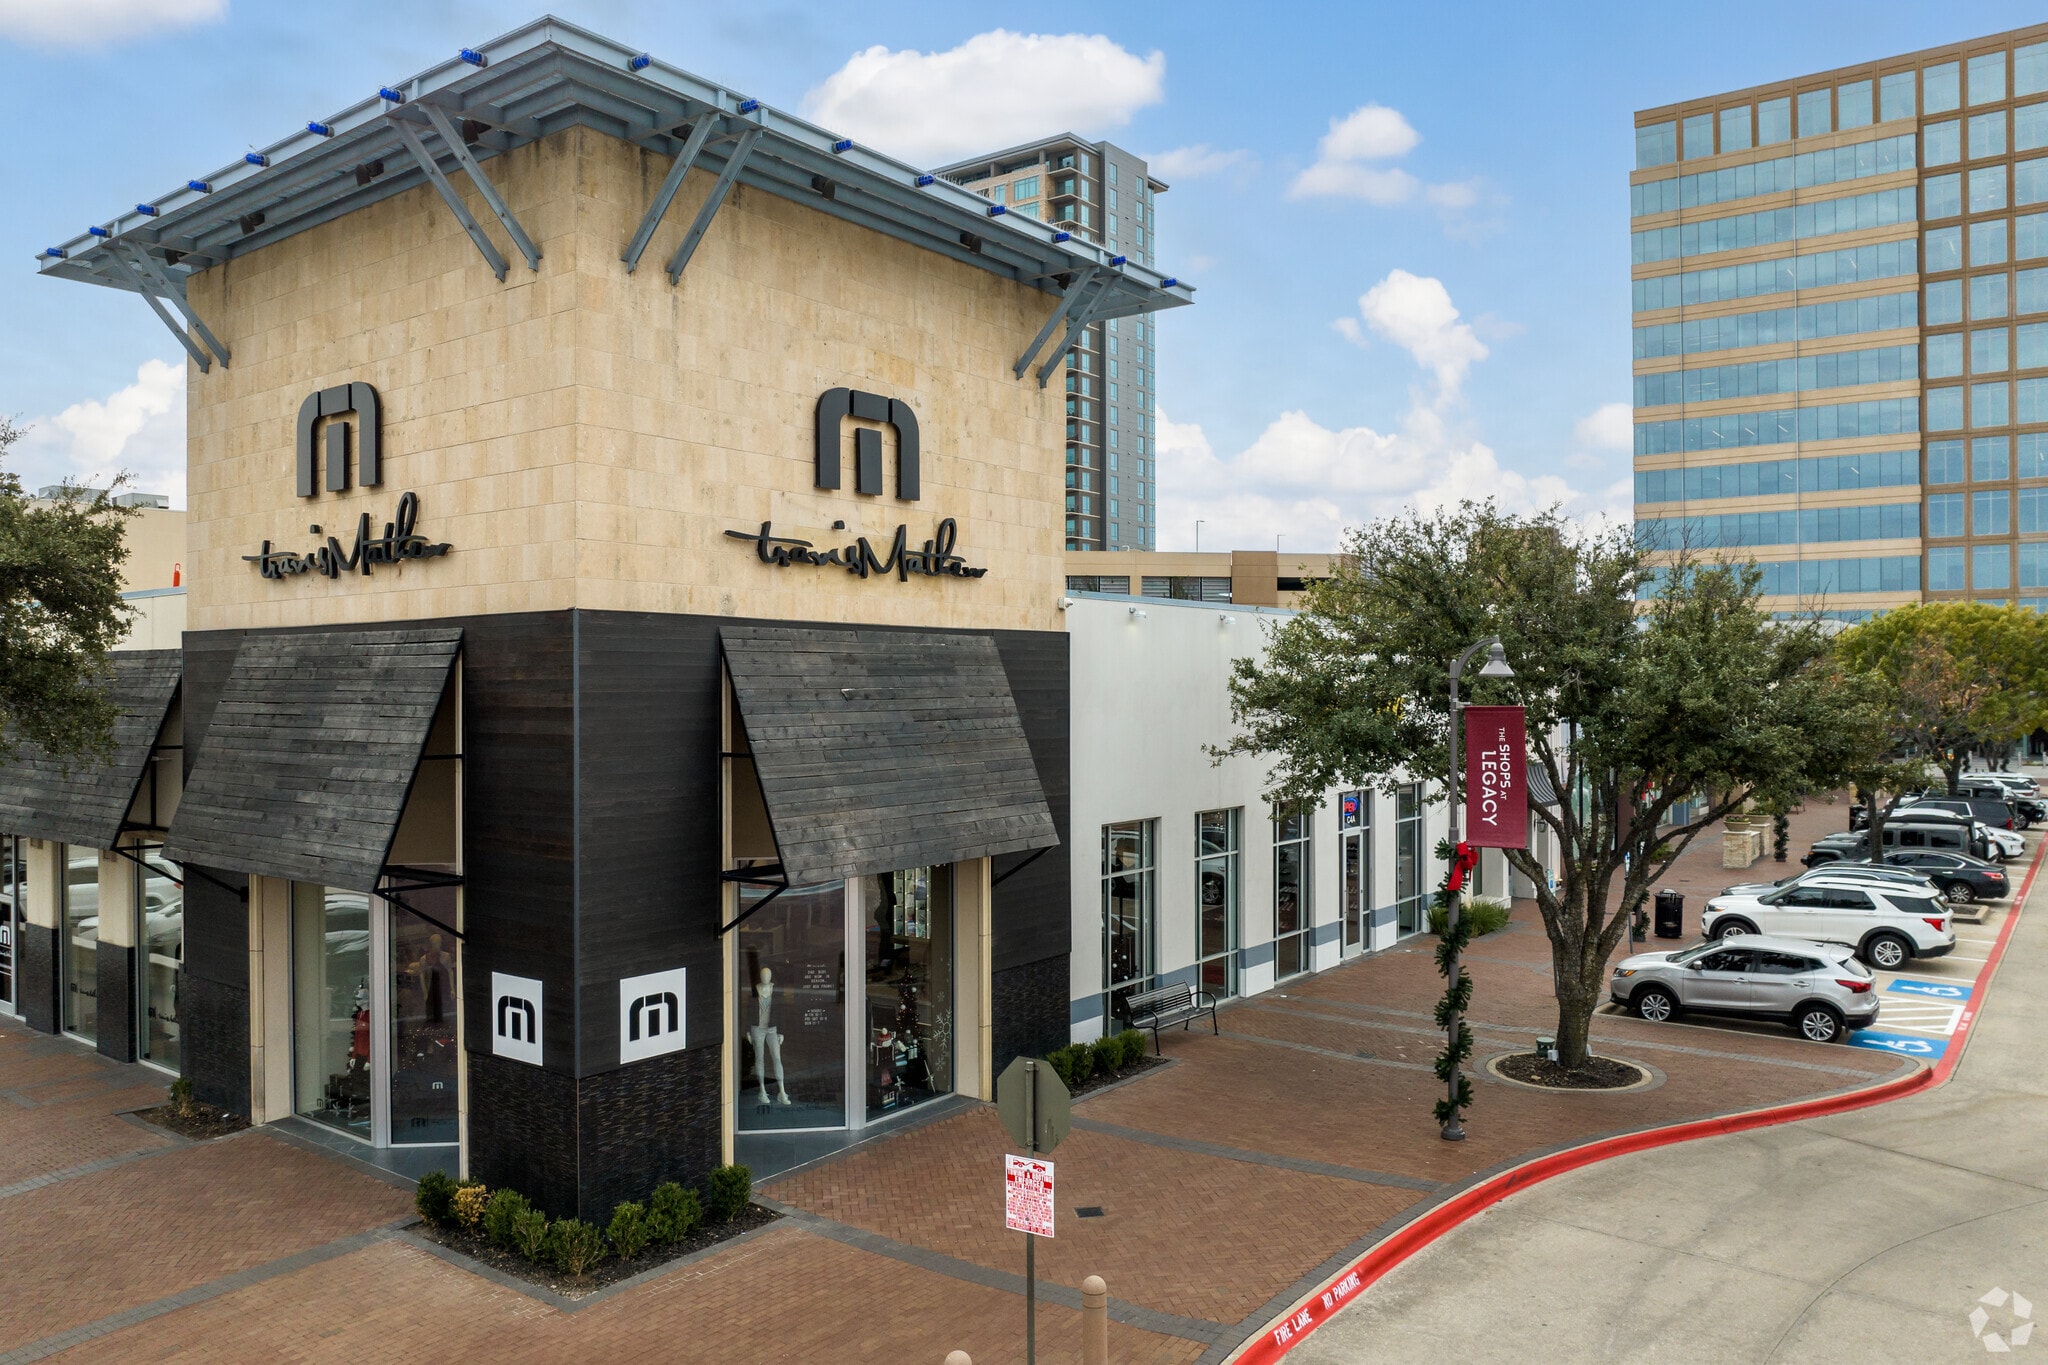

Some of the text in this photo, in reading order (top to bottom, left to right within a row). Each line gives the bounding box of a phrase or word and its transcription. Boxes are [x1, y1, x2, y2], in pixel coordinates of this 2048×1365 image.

[1481, 750, 1498, 826] LEGACY
[1498, 727, 1511, 800] THE SHOPS AT
[1321, 1271, 1360, 1310] NO PARKING
[1273, 1308, 1313, 1346] FIRE LANE
